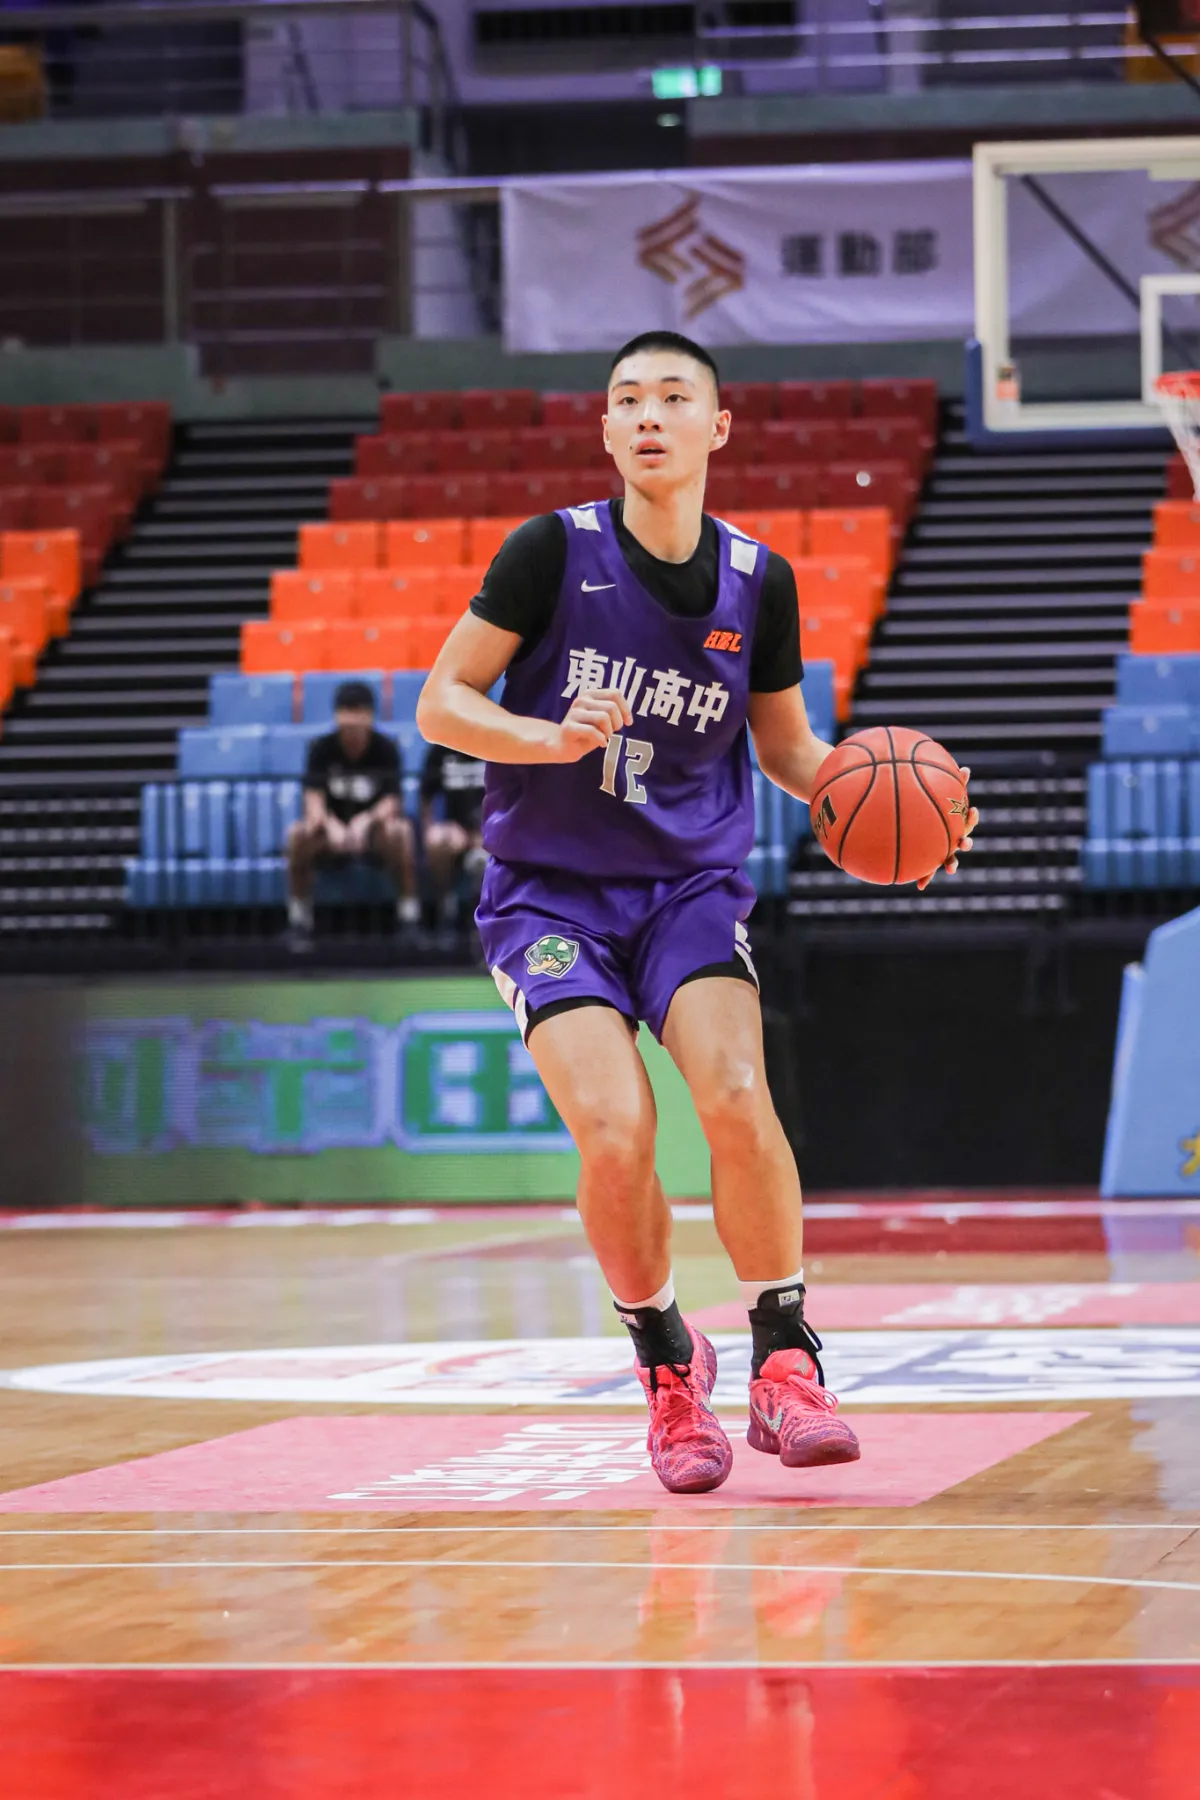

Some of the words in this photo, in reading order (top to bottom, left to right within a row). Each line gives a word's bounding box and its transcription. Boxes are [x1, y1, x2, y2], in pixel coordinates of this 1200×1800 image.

[703, 629, 743, 652] HBL
[561, 647, 730, 734] 東山高中
[599, 733, 655, 805] 12
